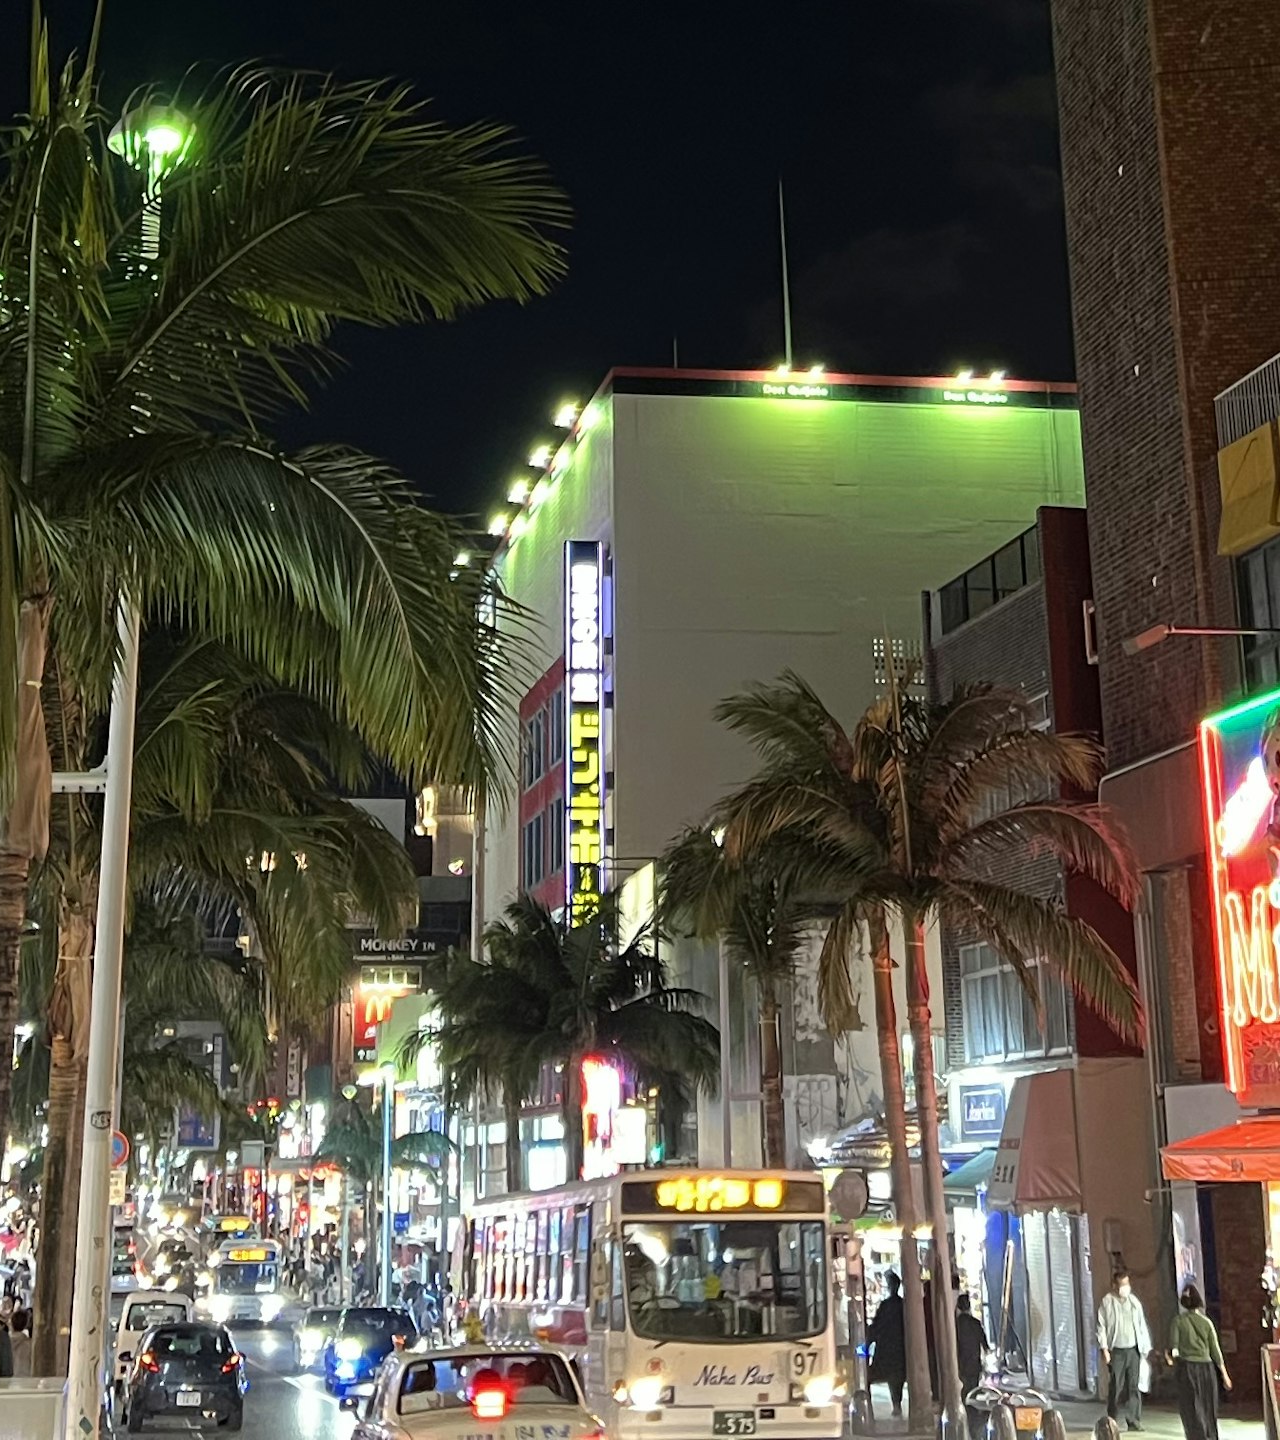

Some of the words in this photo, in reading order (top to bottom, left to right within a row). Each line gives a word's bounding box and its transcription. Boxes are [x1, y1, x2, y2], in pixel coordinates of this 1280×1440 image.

[360, 938, 419, 952] MONKEY
[692, 1364, 737, 1387] Naha
[739, 1364, 775, 1386] Bus
[793, 1351, 819, 1377] 97
